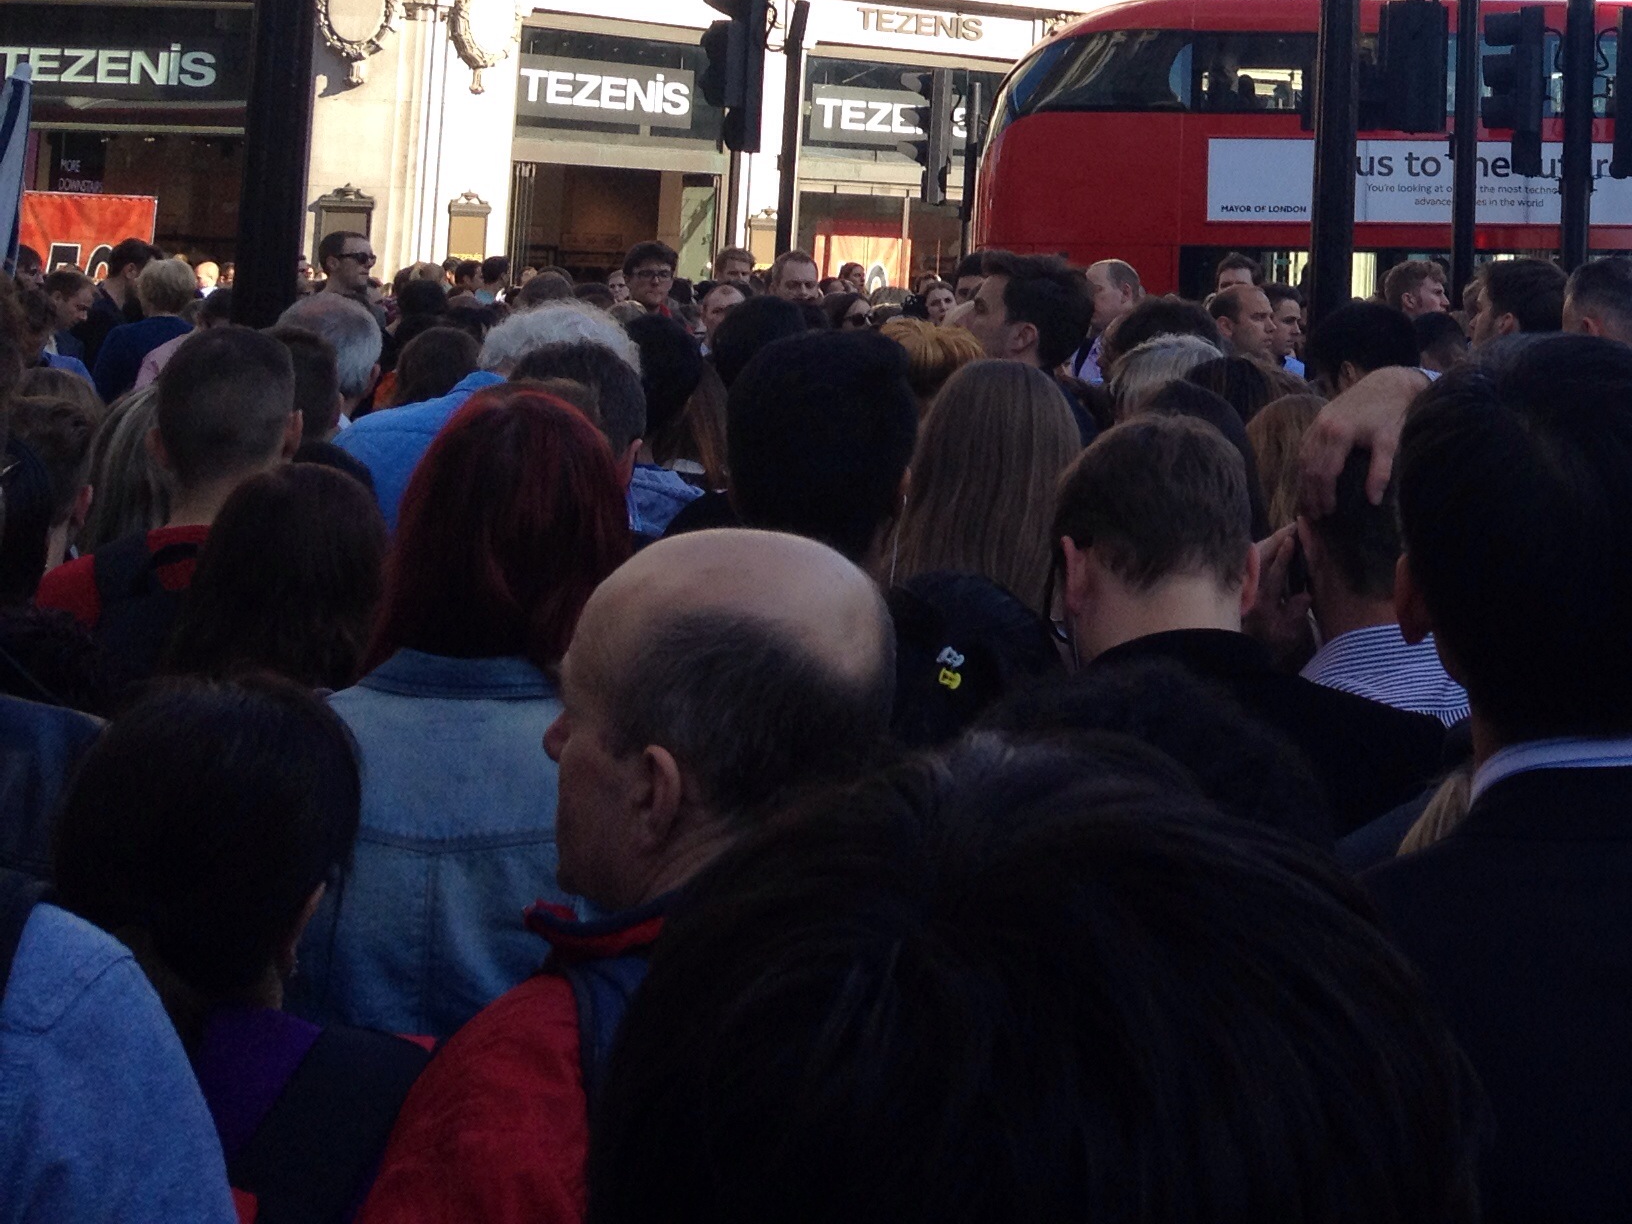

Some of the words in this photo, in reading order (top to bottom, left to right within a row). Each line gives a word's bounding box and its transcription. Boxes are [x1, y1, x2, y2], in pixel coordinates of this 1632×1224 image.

[1354, 155, 1394, 177] us
[1404, 151, 1442, 177] to
[1367, 182, 1395, 193] You're
[1397, 183, 1432, 195] looking
[1434, 185, 1444, 193] at
[1480, 185, 1496, 194] the
[1498, 186, 1522, 194] most
[1414, 197, 1452, 206] advance
[1500, 198, 1515, 207] the
[1517, 199, 1544, 208] world
[1220, 204, 1252, 213] MAYOR
[1254, 204, 1266, 213] OF
[1268, 204, 1307, 214] LONDON
